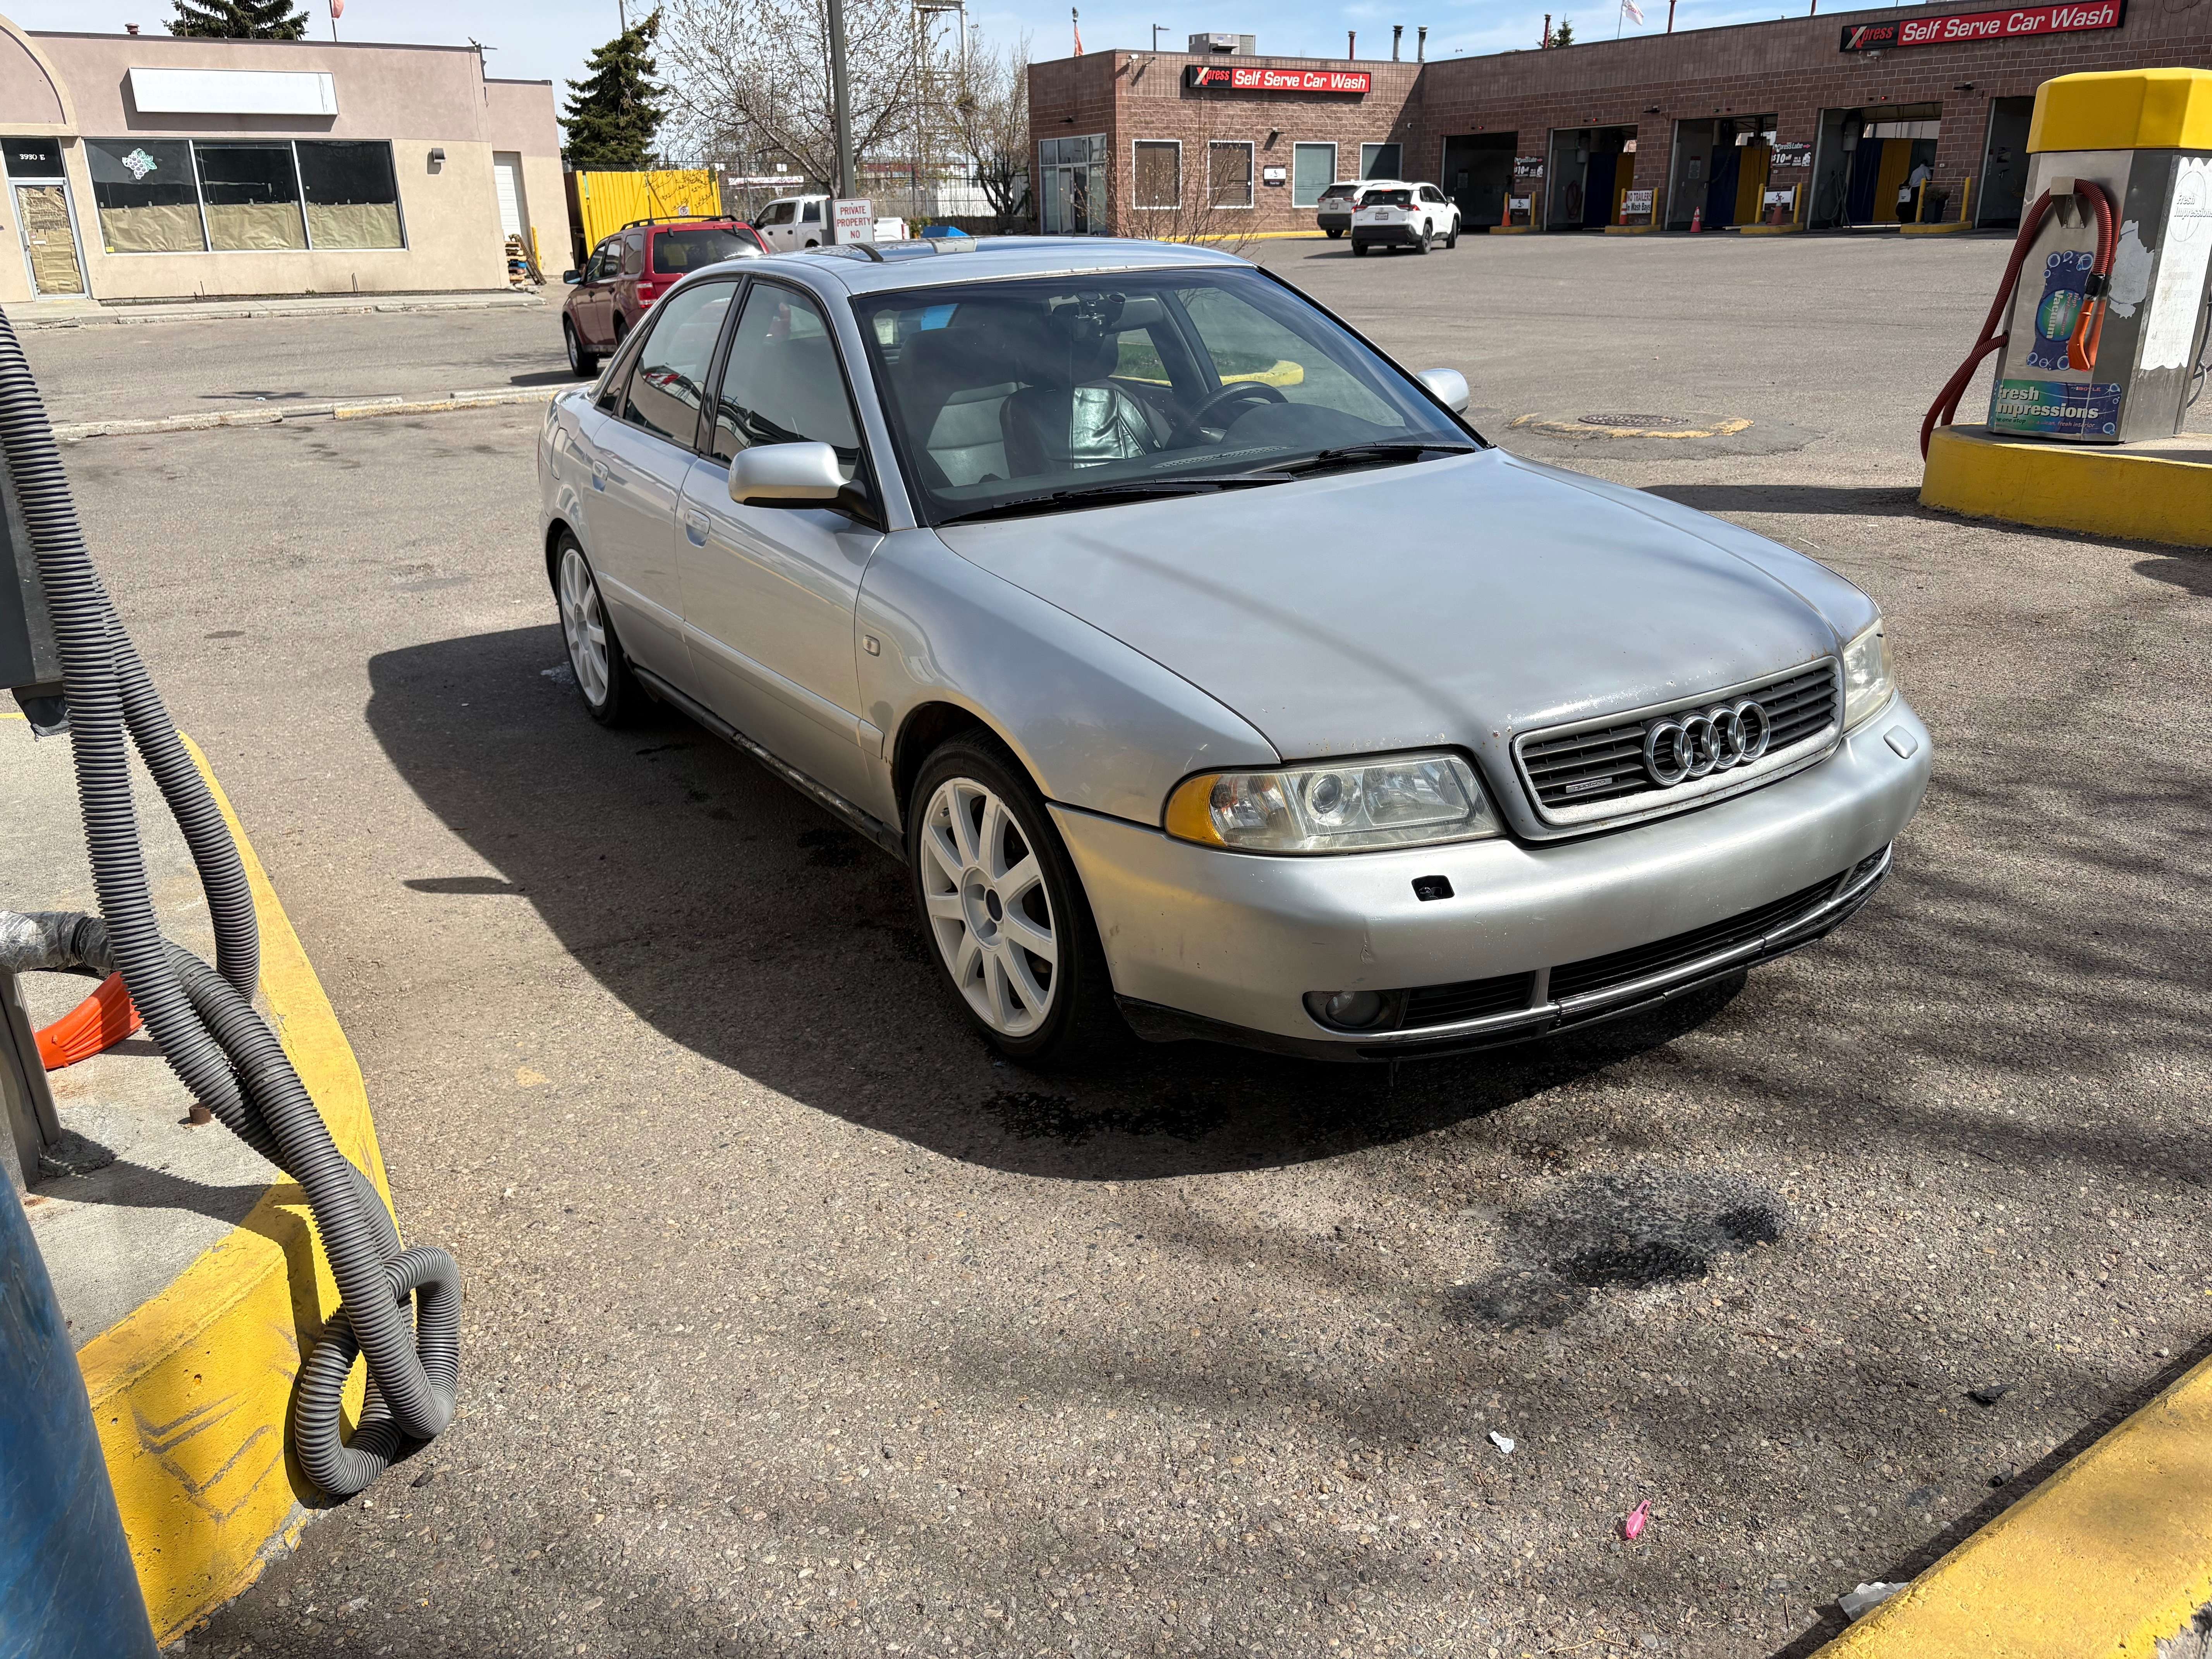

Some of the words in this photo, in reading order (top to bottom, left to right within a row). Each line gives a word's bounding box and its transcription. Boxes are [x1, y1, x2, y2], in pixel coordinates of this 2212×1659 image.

[1845, 26, 1894, 49] Xpress
[1903, 21, 1942, 41] Self
[1944, 19, 2001, 38] Serve
[2007, 13, 2045, 32] Car
[2051, 4, 2113, 28] Wash
[1194, 67, 1230, 85] Xpress
[1235, 70, 1262, 85] Self
[1264, 71, 1300, 87] Serve
[1303, 72, 1327, 88] Car
[1331, 74, 1366, 89] Wash
[1634, 192, 1652, 201] TRAILERS
[840, 206, 866, 215] PRIVATE
[837, 217, 871, 227] PROPERTY
[850, 230, 860, 239] NO
[2046, 290, 2064, 338] Vacuum
